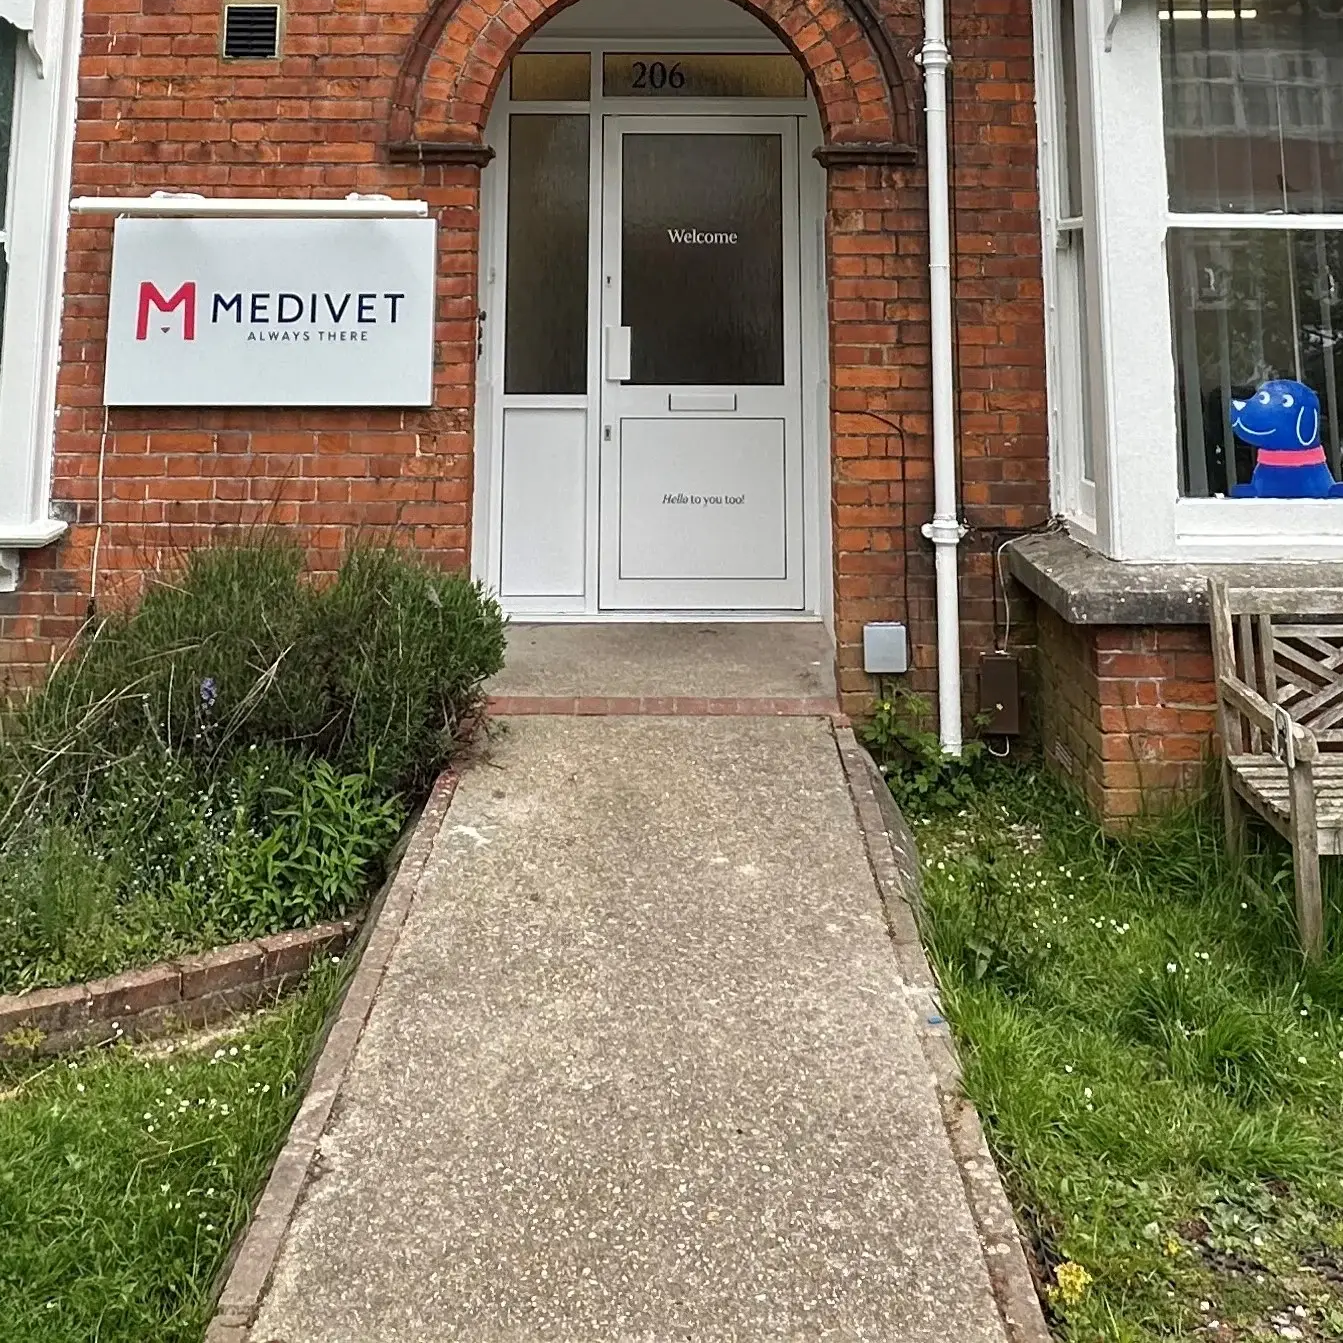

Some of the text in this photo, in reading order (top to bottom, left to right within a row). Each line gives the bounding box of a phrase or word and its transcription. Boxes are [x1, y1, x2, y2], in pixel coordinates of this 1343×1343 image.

[632, 61, 685, 89] 206
[668, 229, 738, 244] Welcome
[211, 293, 405, 323] MEDIVET
[247, 330, 368, 341] ALWAYS THERE
[662, 493, 745, 508] Hello to you too!
